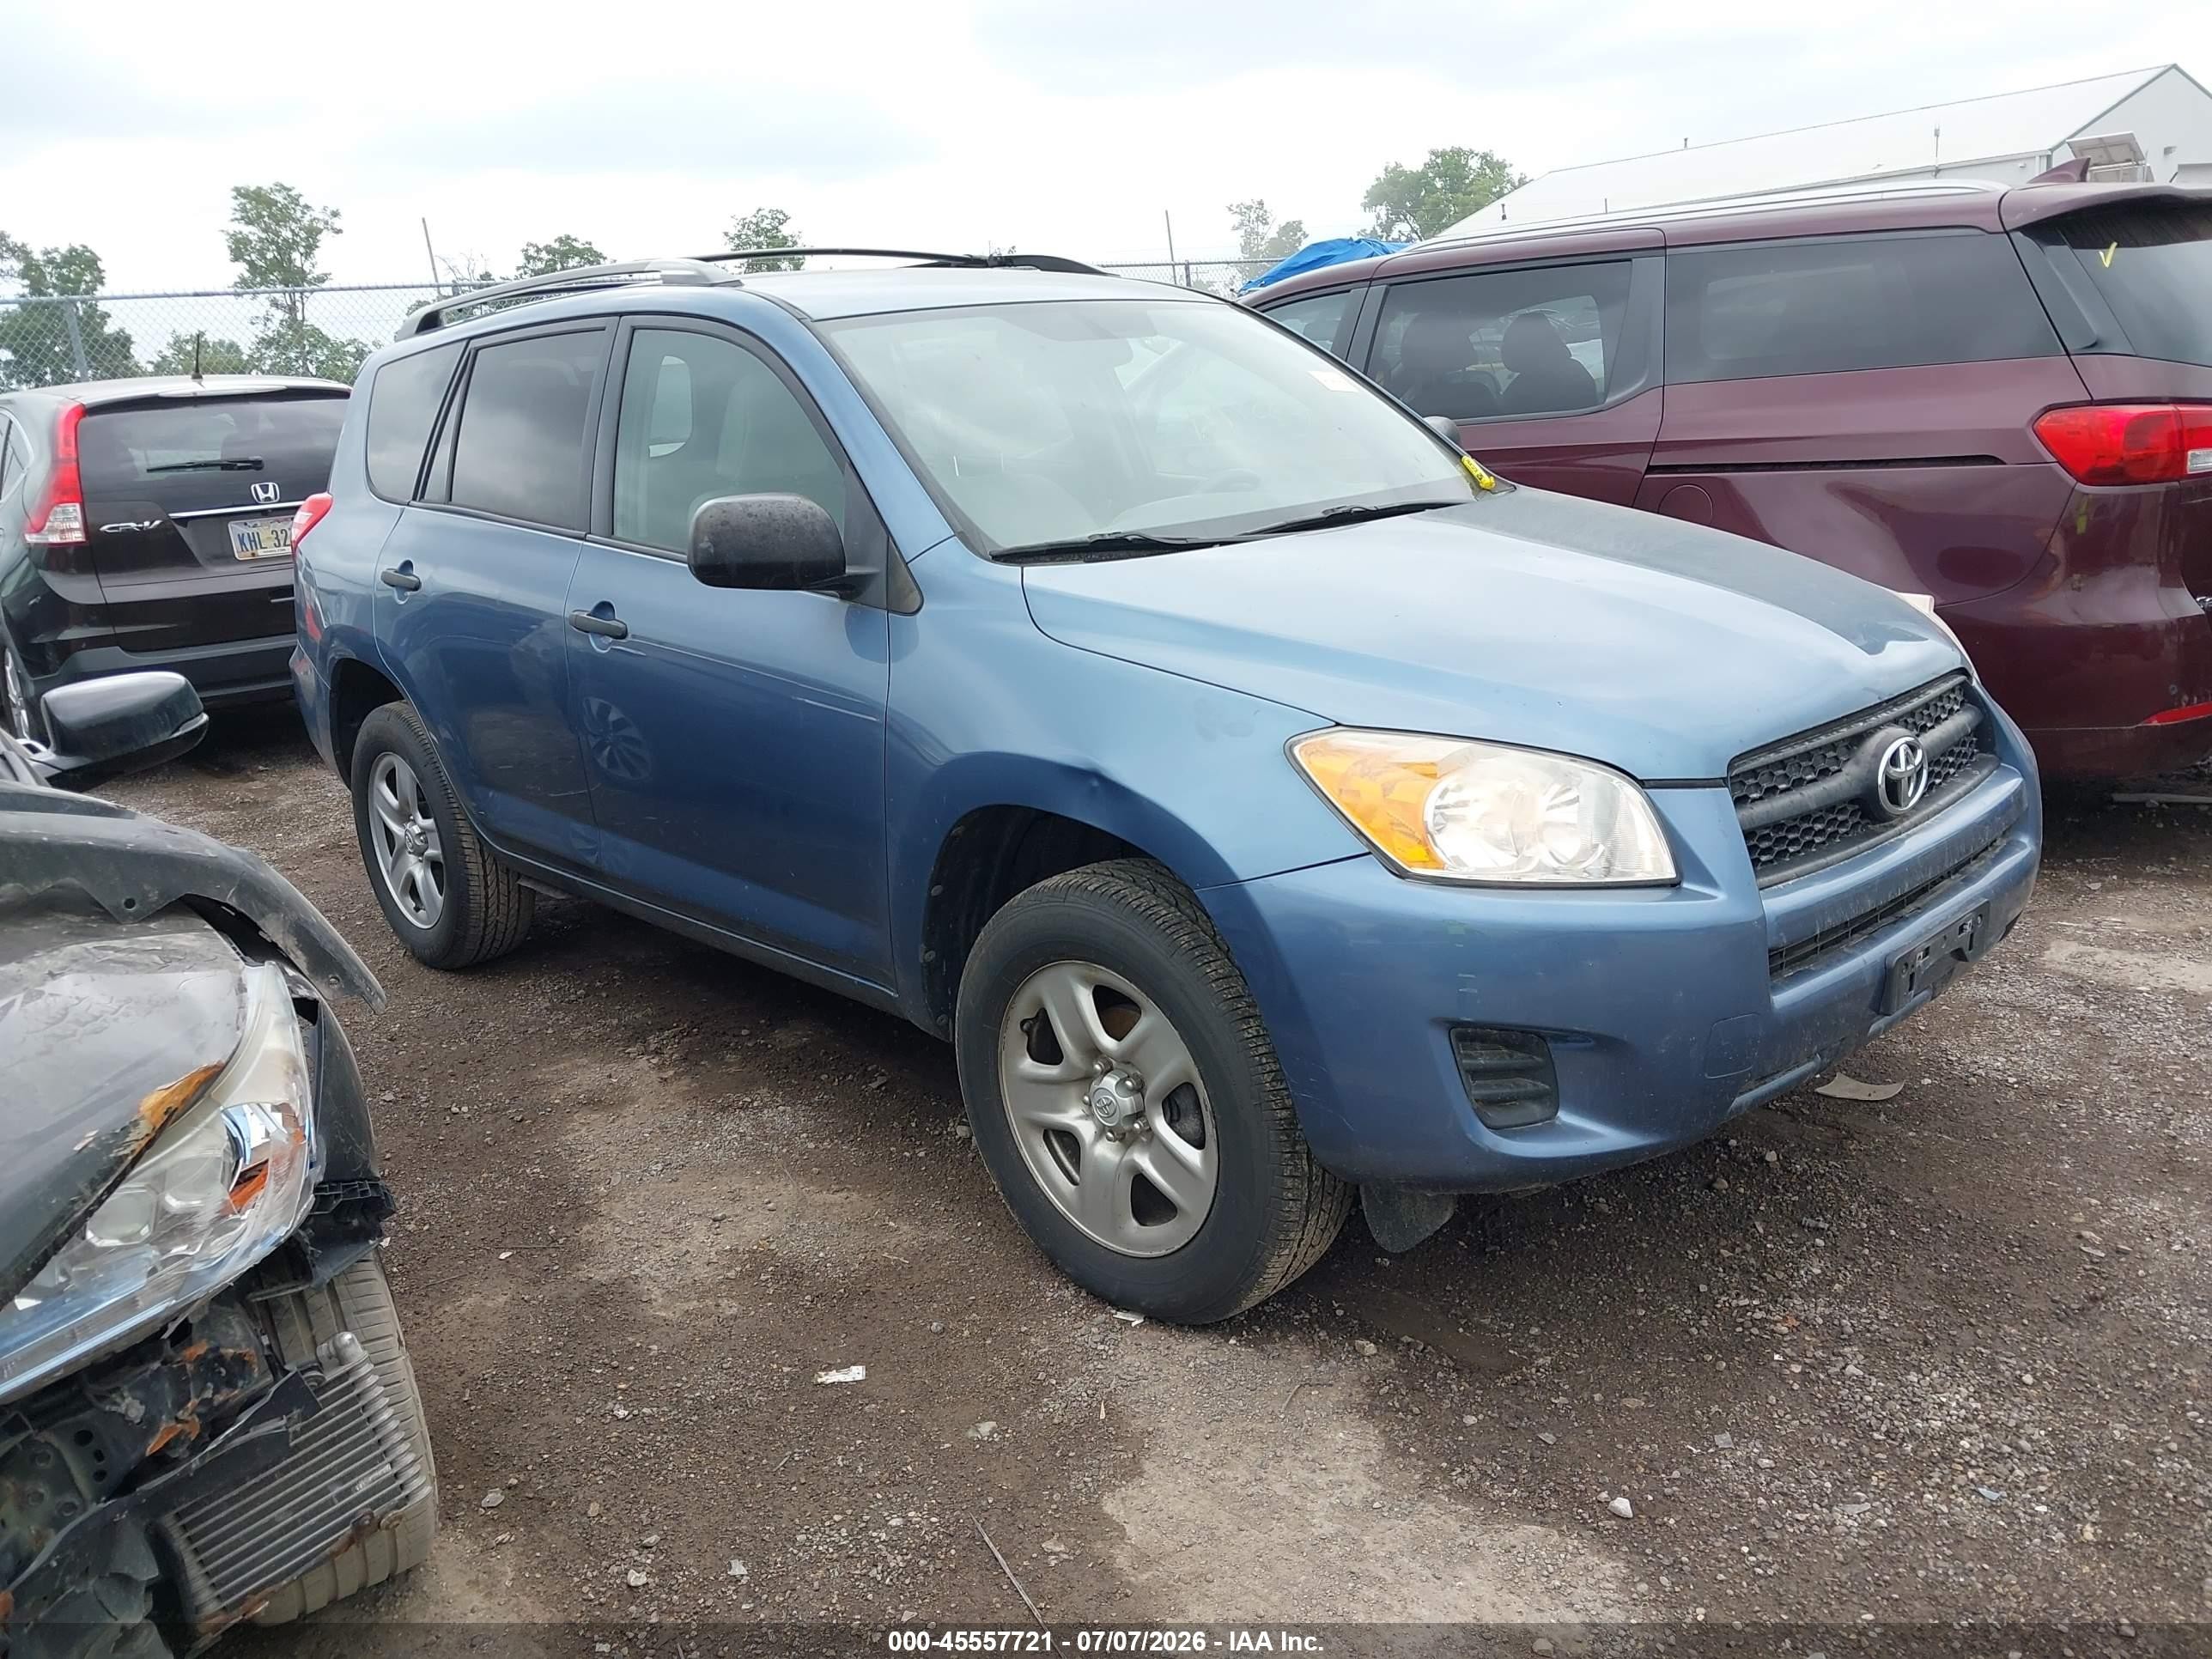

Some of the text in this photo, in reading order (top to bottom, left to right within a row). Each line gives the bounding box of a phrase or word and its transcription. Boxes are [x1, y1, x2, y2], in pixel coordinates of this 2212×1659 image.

[99, 520, 163, 533] CR-V
[237, 528, 292, 552] KHL 32
